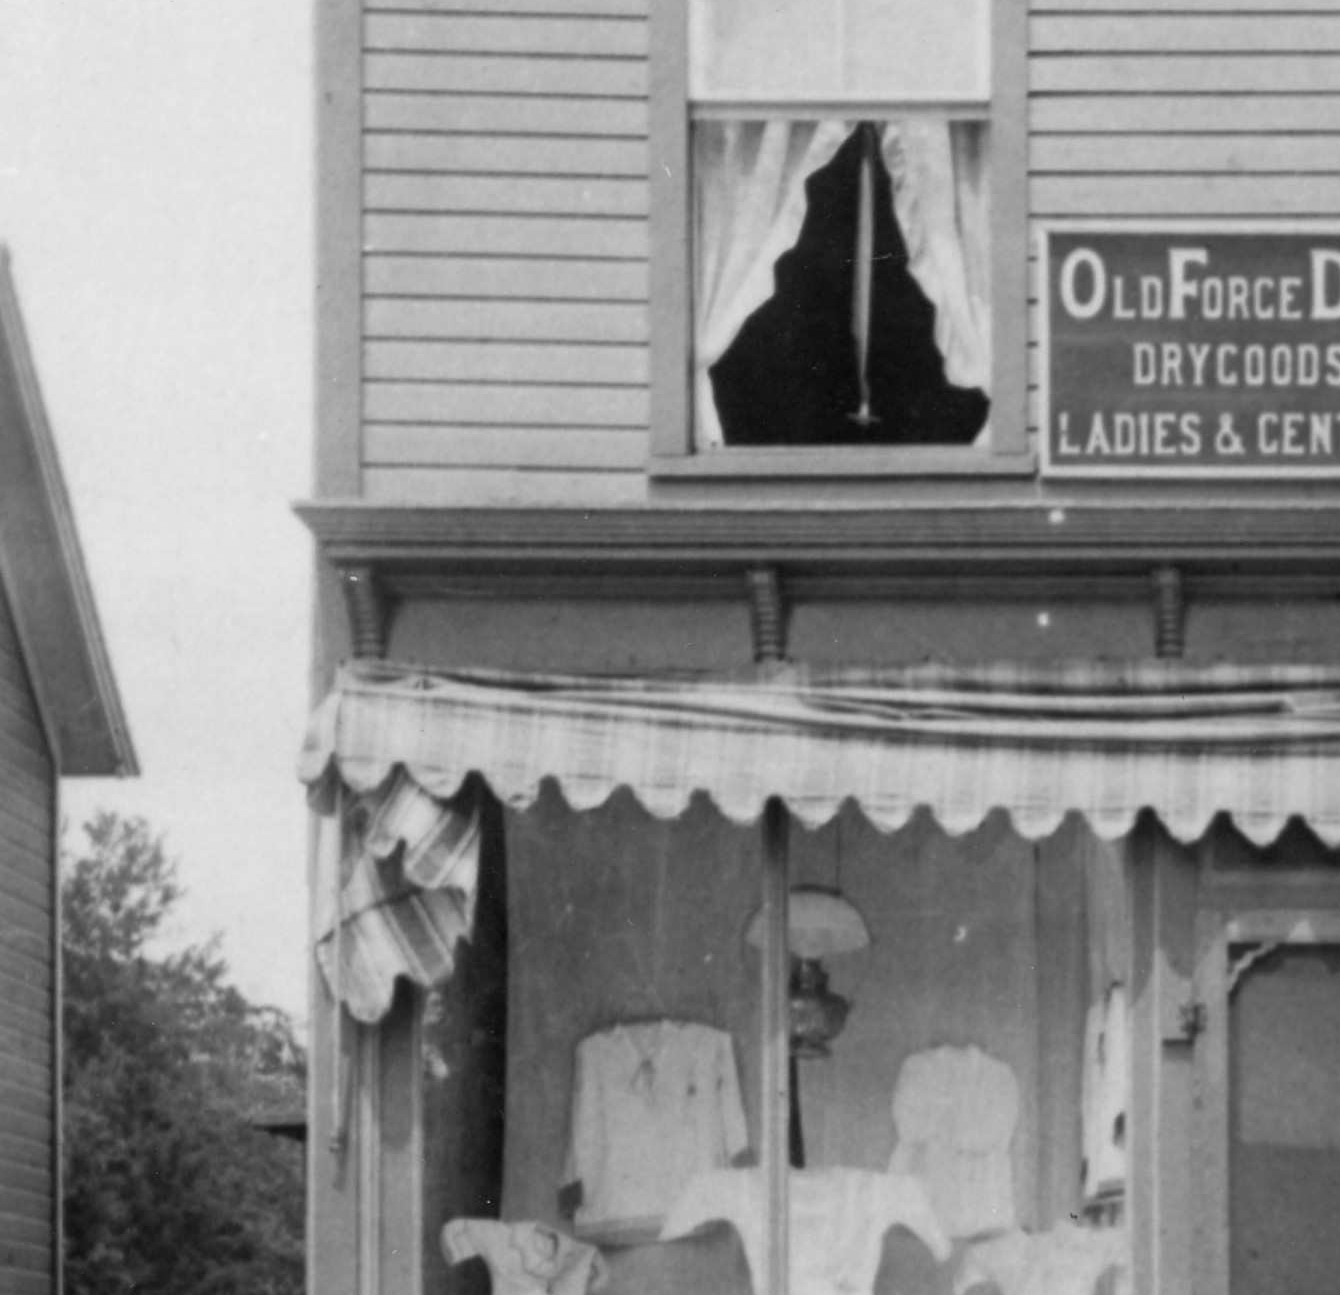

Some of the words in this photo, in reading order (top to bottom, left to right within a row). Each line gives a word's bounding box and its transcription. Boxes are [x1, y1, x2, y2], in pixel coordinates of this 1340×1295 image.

[1058, 247, 1164, 321] OLD
[1058, 411, 1203, 456] LADIES
[1214, 412, 1246, 456] &
